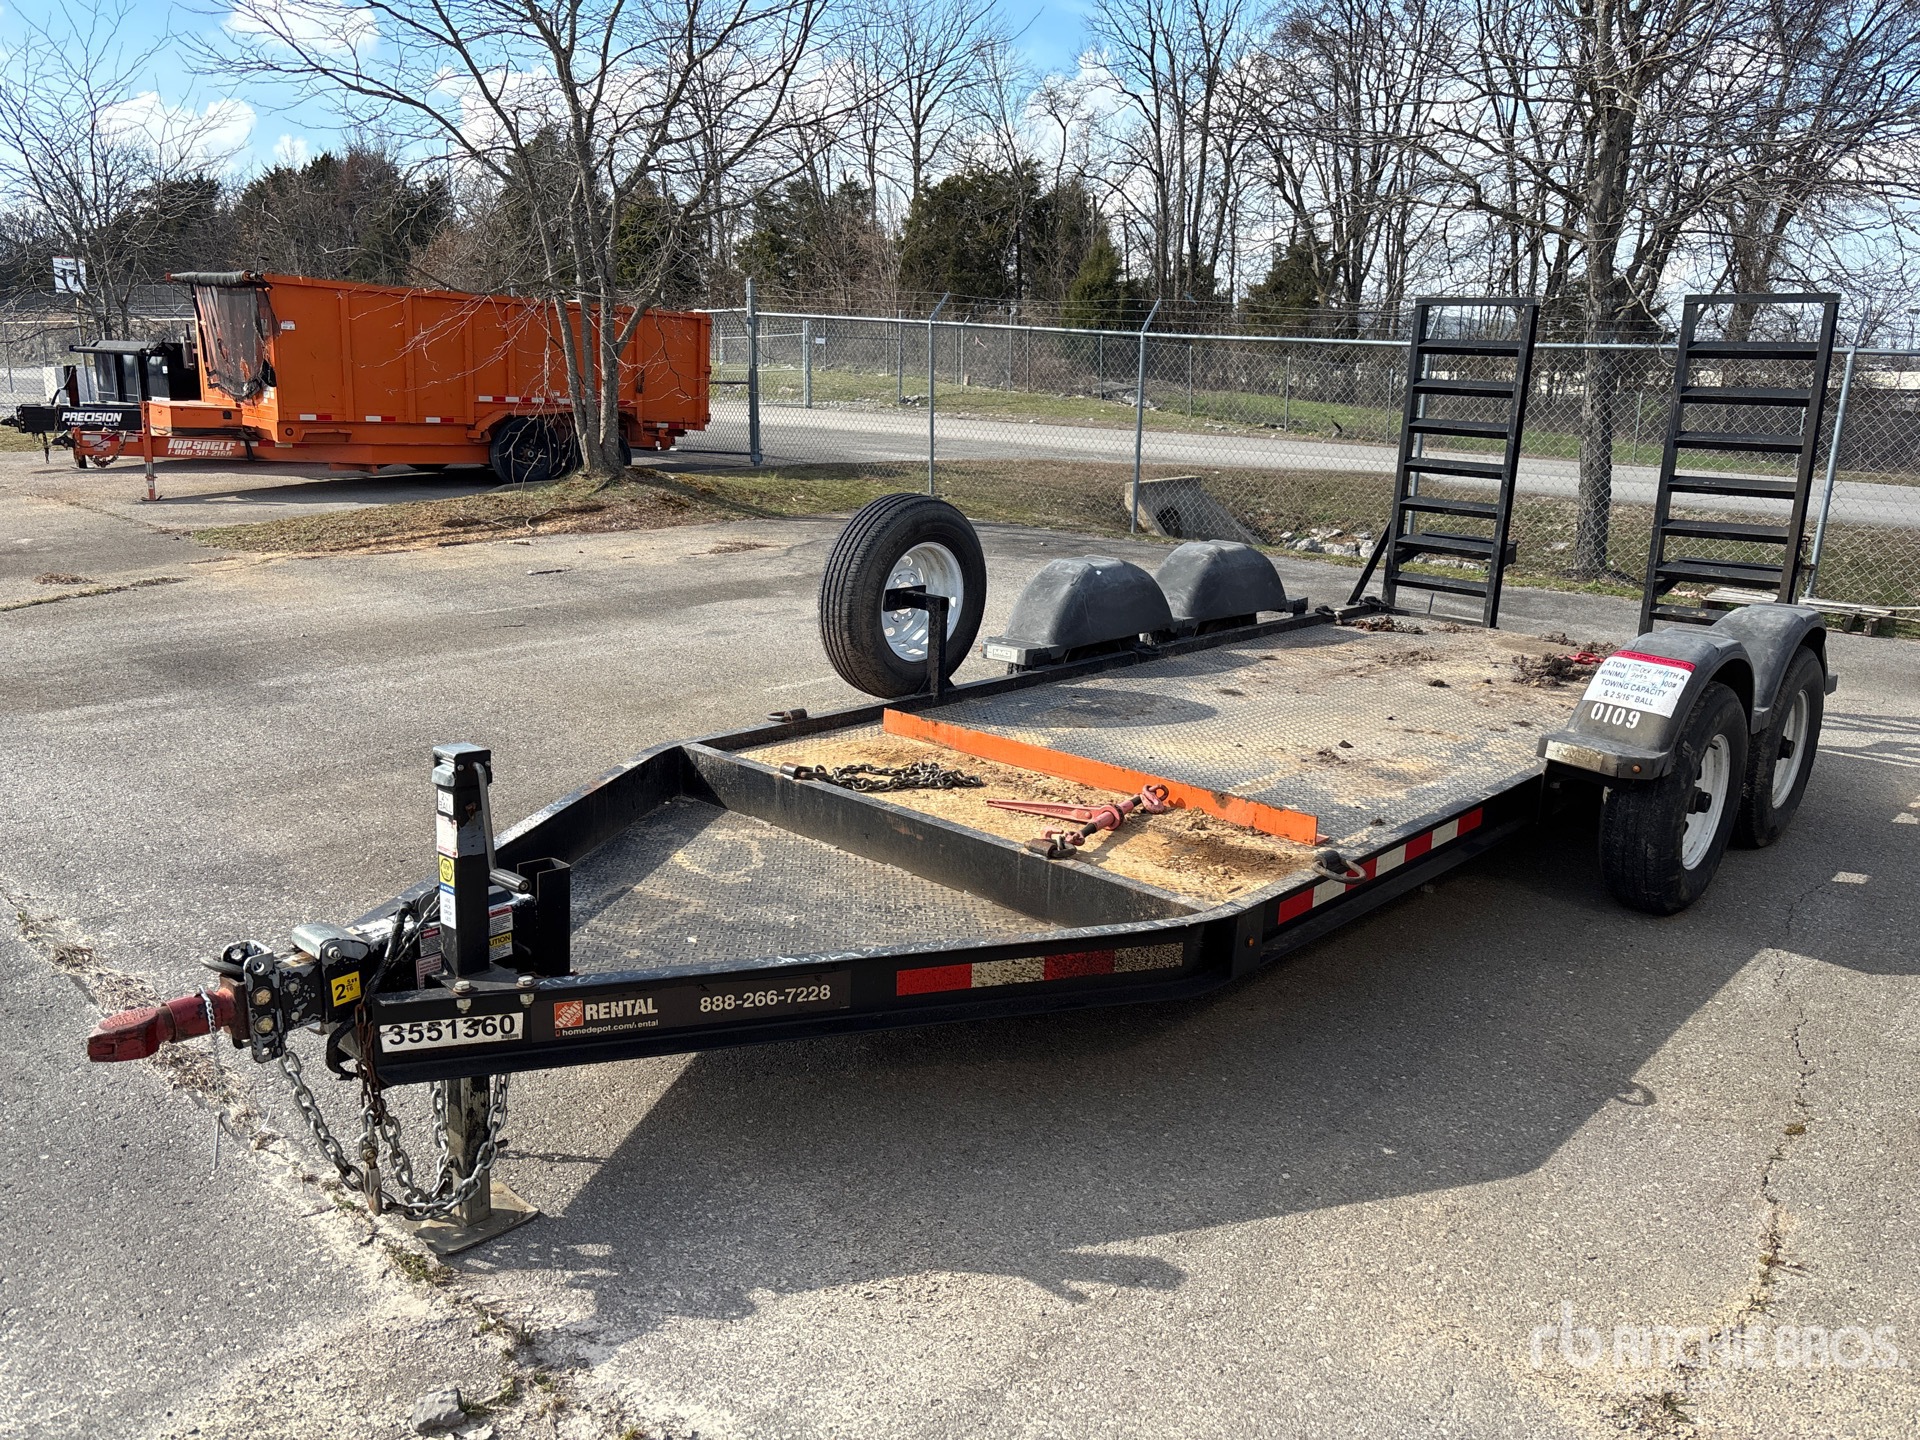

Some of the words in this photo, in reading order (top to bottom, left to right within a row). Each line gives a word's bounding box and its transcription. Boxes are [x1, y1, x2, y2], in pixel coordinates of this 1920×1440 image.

[61, 412, 123, 422] PRECISION
[1600, 669, 1626, 679] MINIMU
[1612, 661, 1628, 669] TON
[1601, 678, 1630, 690] TOWING
[1630, 683, 1668, 698] CAPACITY
[1603, 689, 1609, 697] &
[1609, 690, 1614, 698] 2
[1634, 696, 1654, 706] BALL
[1590, 702, 1641, 729] 0109
[489, 934, 511, 947] UTION
[335, 983, 347, 1001] 2
[699, 984, 831, 1013] 888-266-7228
[555, 1000, 582, 1027] HOME
[558, 1004, 571, 1016] THE
[585, 997, 658, 1020] RENTAL
[388, 1013, 516, 1046] 3551360
